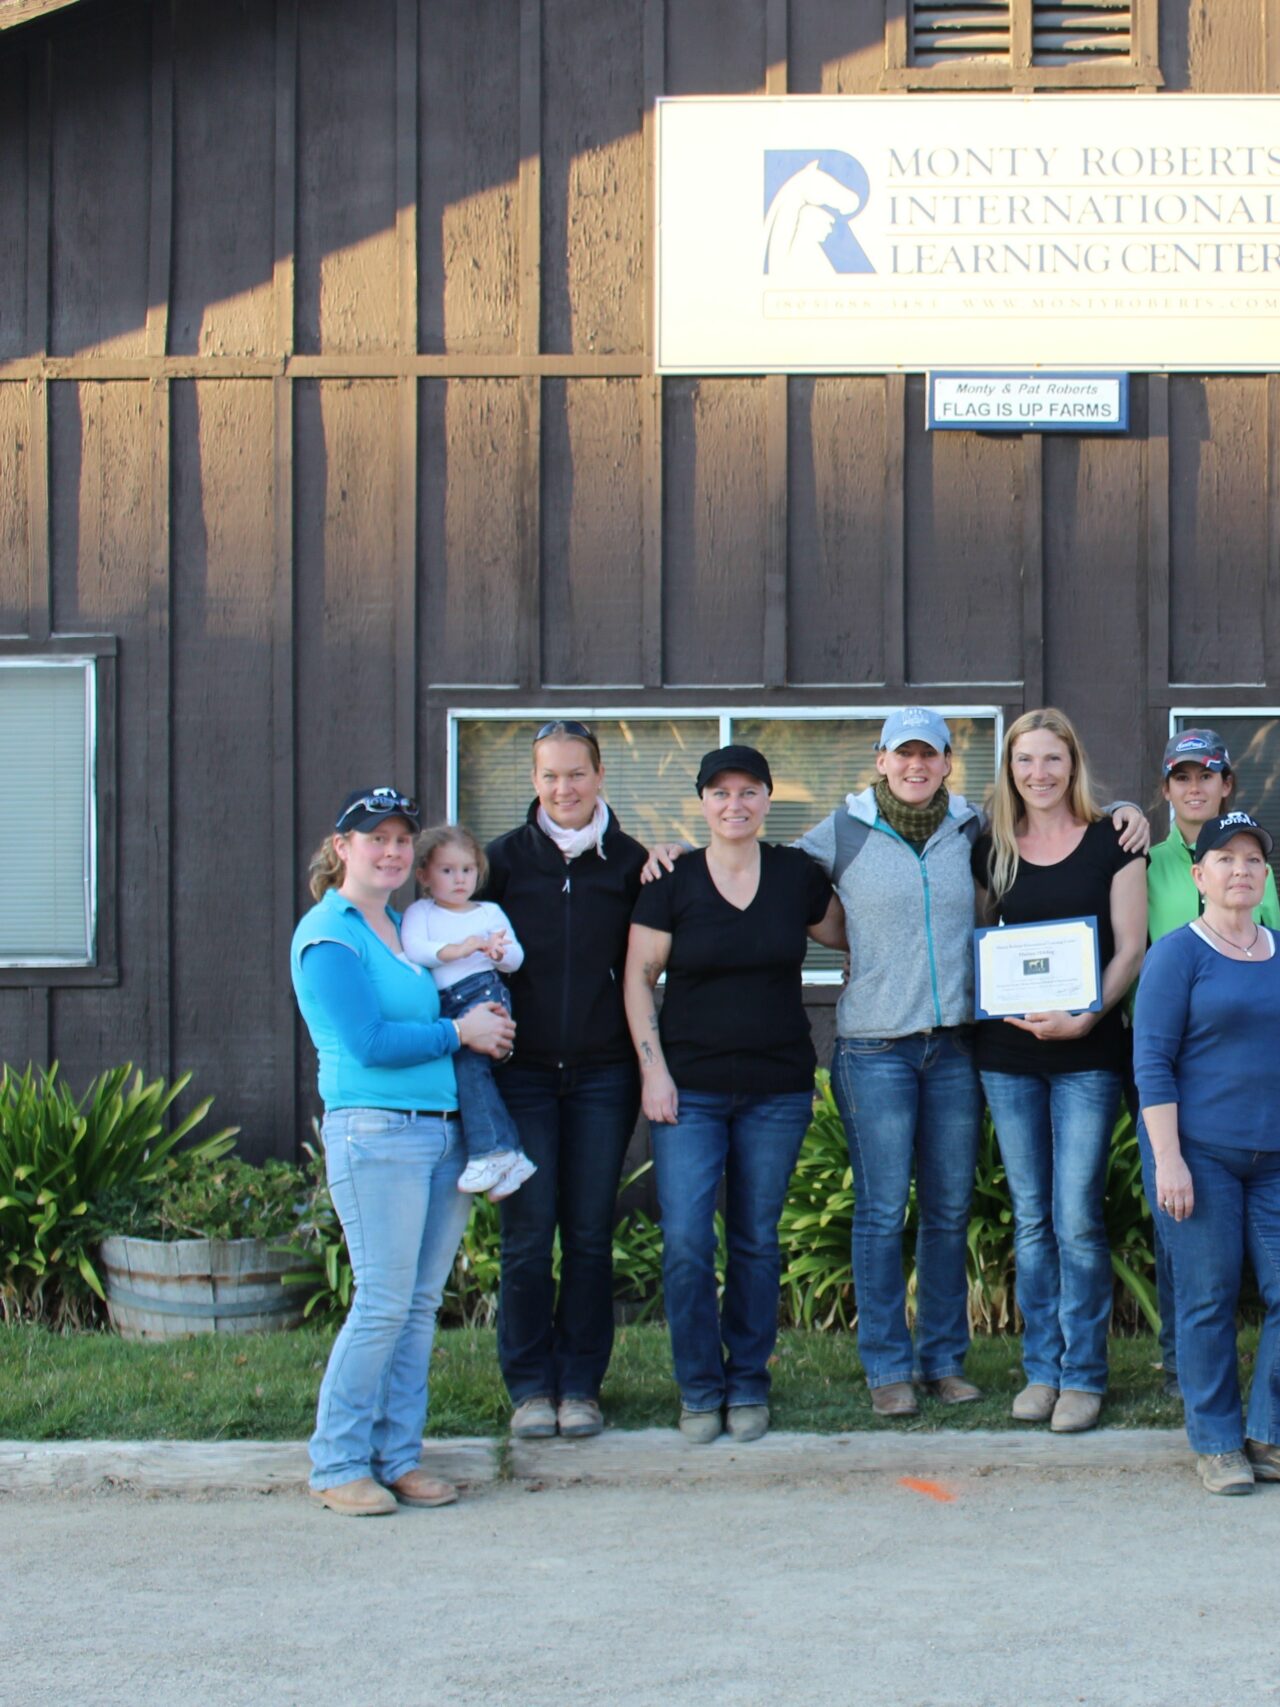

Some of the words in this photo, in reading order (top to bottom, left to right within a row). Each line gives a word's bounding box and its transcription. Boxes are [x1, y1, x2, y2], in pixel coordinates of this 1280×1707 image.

[888, 146, 1058, 177] MONTY
[891, 243, 1112, 274] LEARNING
[955, 383, 996, 396] Monty
[1001, 383, 1012, 395] &
[1017, 383, 1041, 395] Pat
[1046, 383, 1098, 395] Roberts
[943, 402, 991, 417] FLAG
[996, 402, 1013, 417] IS
[1019, 402, 1043, 417] UP
[1049, 402, 1112, 417] FARMS
